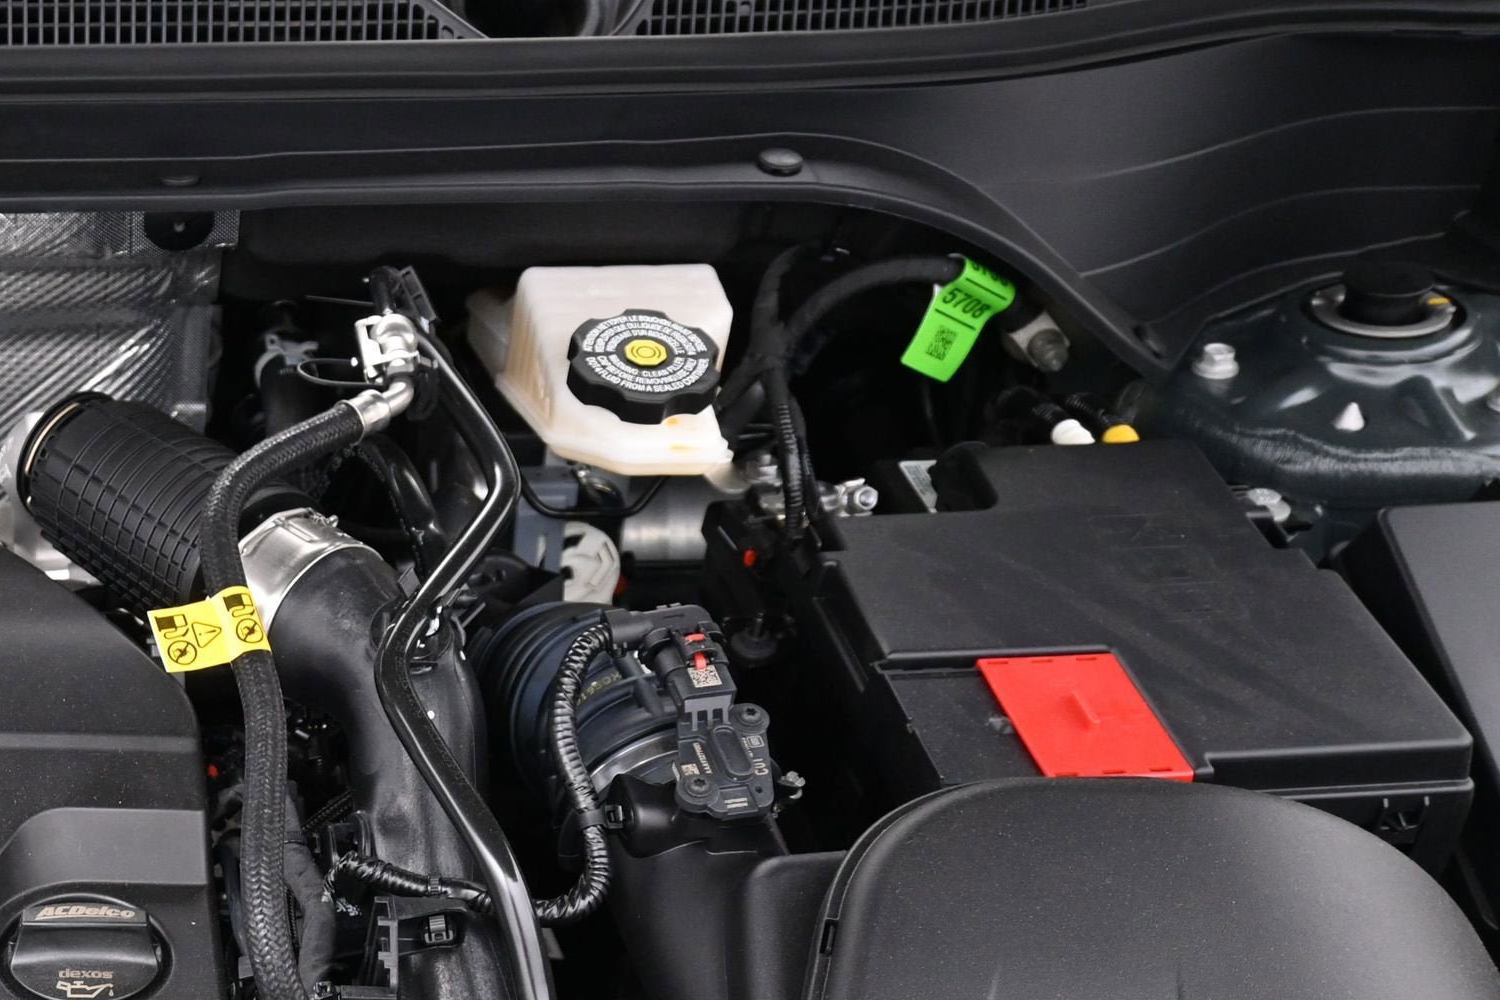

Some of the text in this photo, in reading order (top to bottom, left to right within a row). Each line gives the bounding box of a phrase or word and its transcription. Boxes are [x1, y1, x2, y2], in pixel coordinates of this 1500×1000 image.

[942, 287, 991, 319] 5708
[619, 379, 646, 392] FROM
[653, 381, 685, 393] SEALED
[35, 905, 135, 922] ACDelco
[59, 968, 115, 979] dexos
